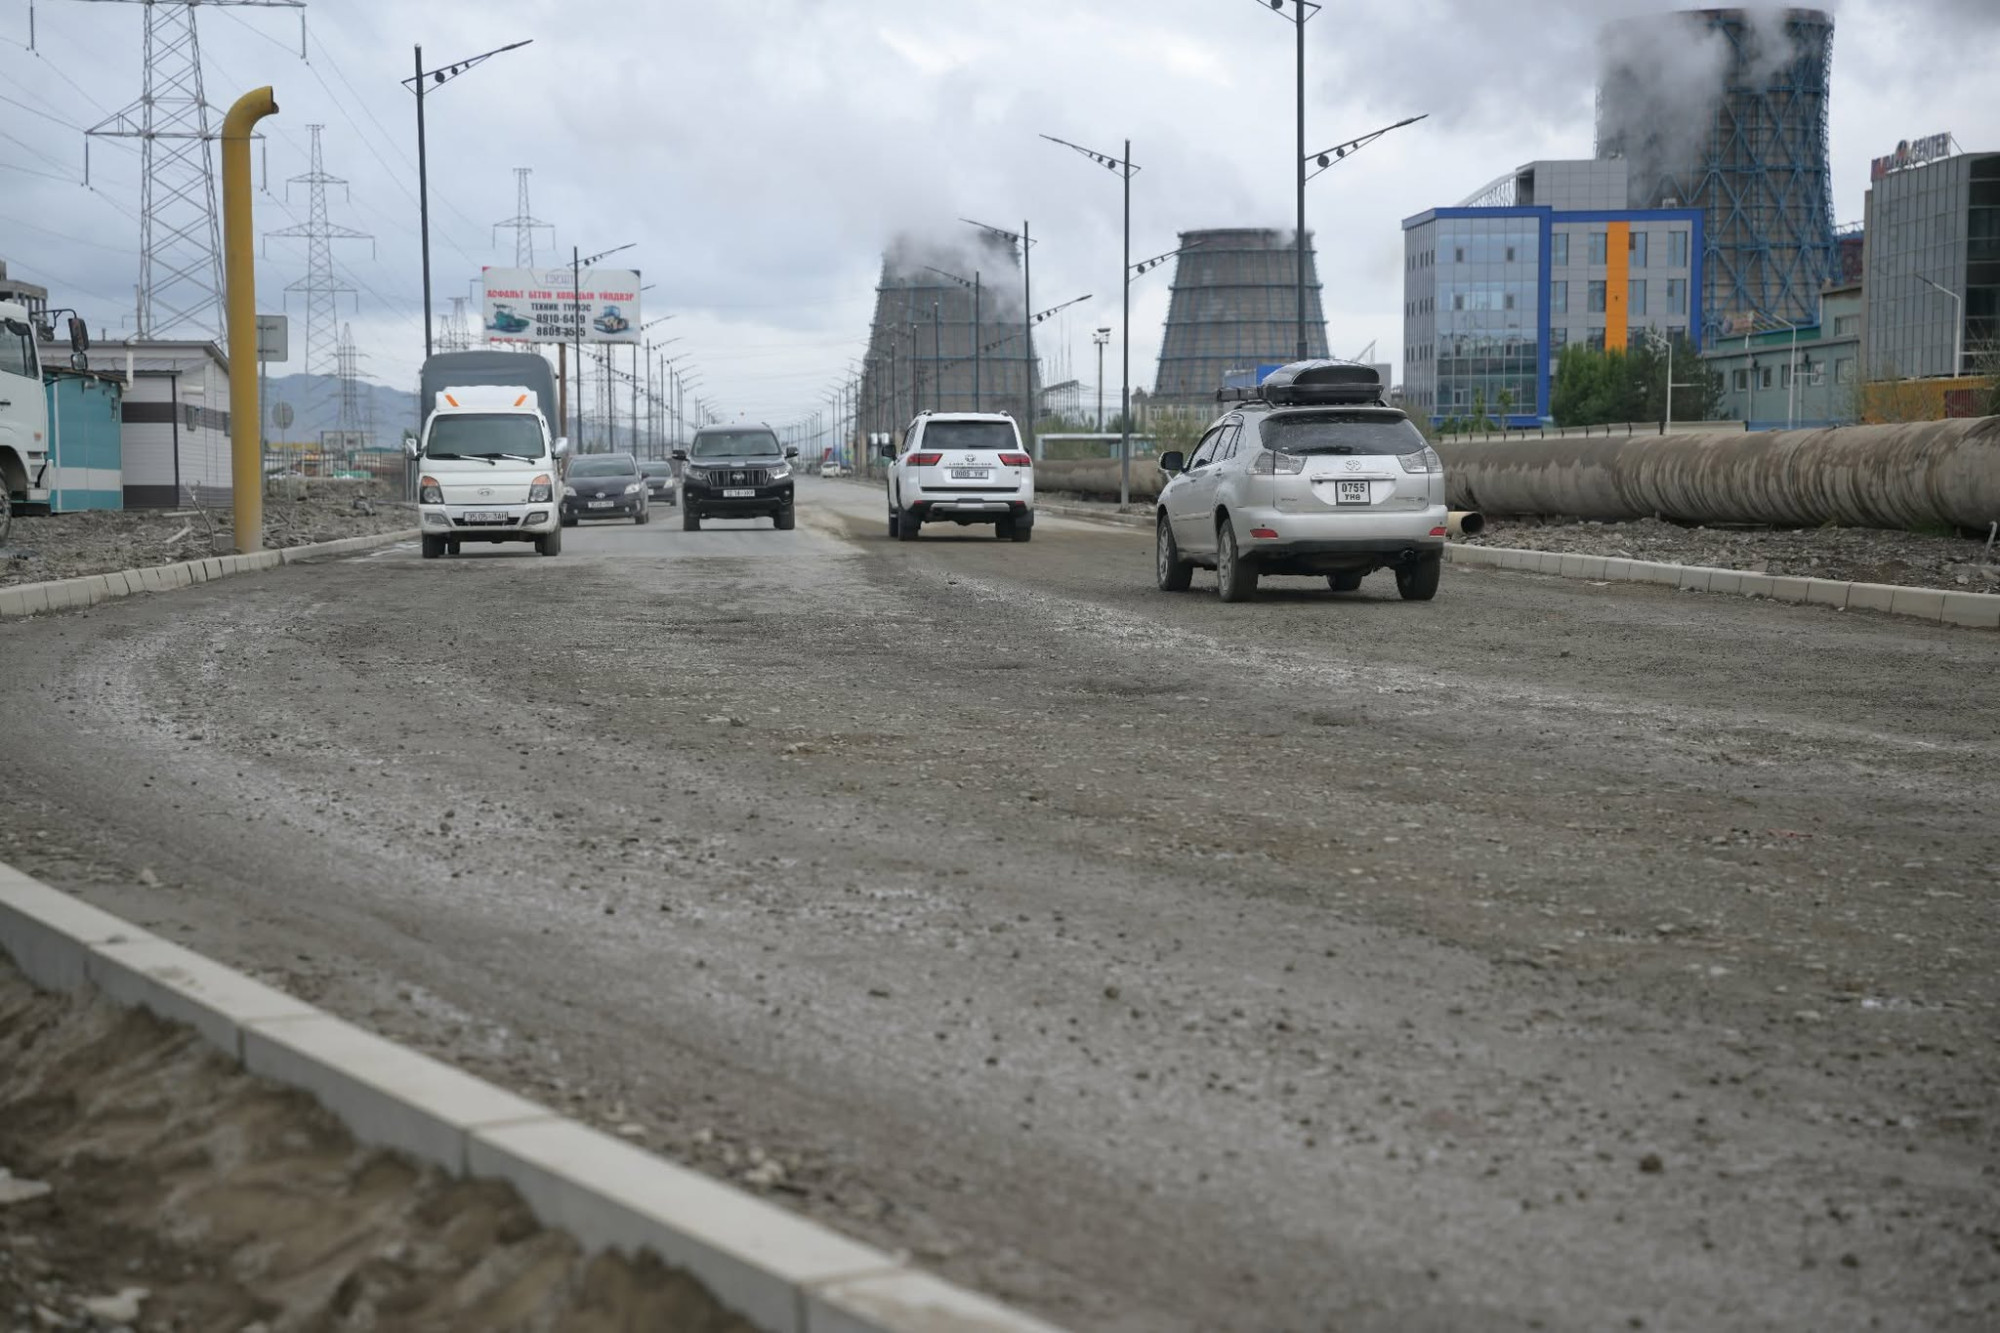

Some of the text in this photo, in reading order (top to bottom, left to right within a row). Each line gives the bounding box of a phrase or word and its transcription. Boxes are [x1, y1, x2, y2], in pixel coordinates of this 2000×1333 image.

[487, 290, 524, 299] АСФАЛЬТ
[528, 290, 552, 299] БЕТОН
[1341, 483, 1366, 493] 0755
